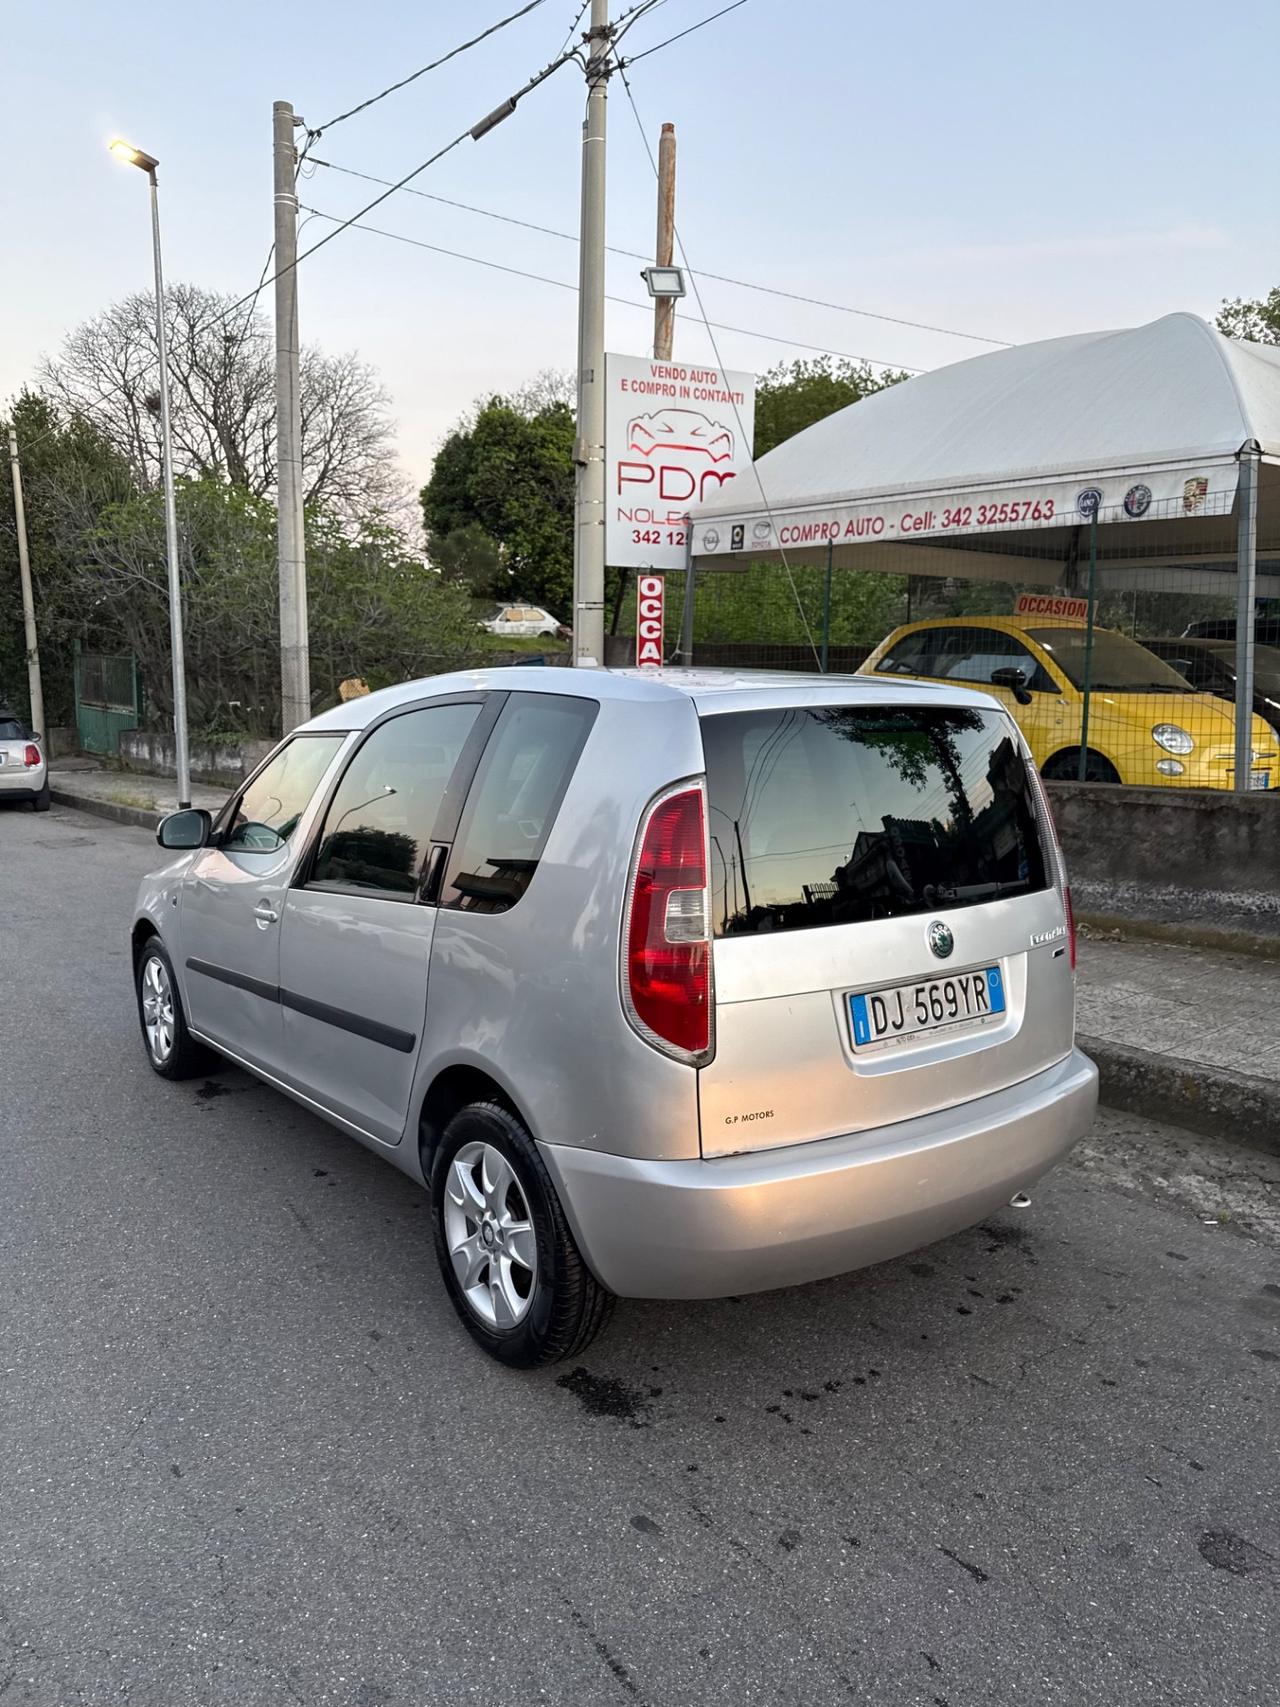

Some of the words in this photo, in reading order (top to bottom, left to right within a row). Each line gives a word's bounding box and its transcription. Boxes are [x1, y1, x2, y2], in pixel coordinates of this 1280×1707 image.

[651, 365, 687, 381] VENDO
[690, 370, 718, 385] AUTO
[621, 379, 629, 392] E
[631, 380, 677, 397] COMPRO
[679, 386, 691, 398] IN
[693, 387, 745, 405] CONTANTI
[780, 521, 841, 544] COMPRO
[844, 516, 885, 537] AUTO
[900, 511, 937, 532] Cell:
[941, 506, 972, 529] 342
[976, 499, 1055, 526] 3255763
[632, 530, 661, 545] 342
[666, 532, 689, 546] 12
[741, 1109, 775, 1122] MOTORS
